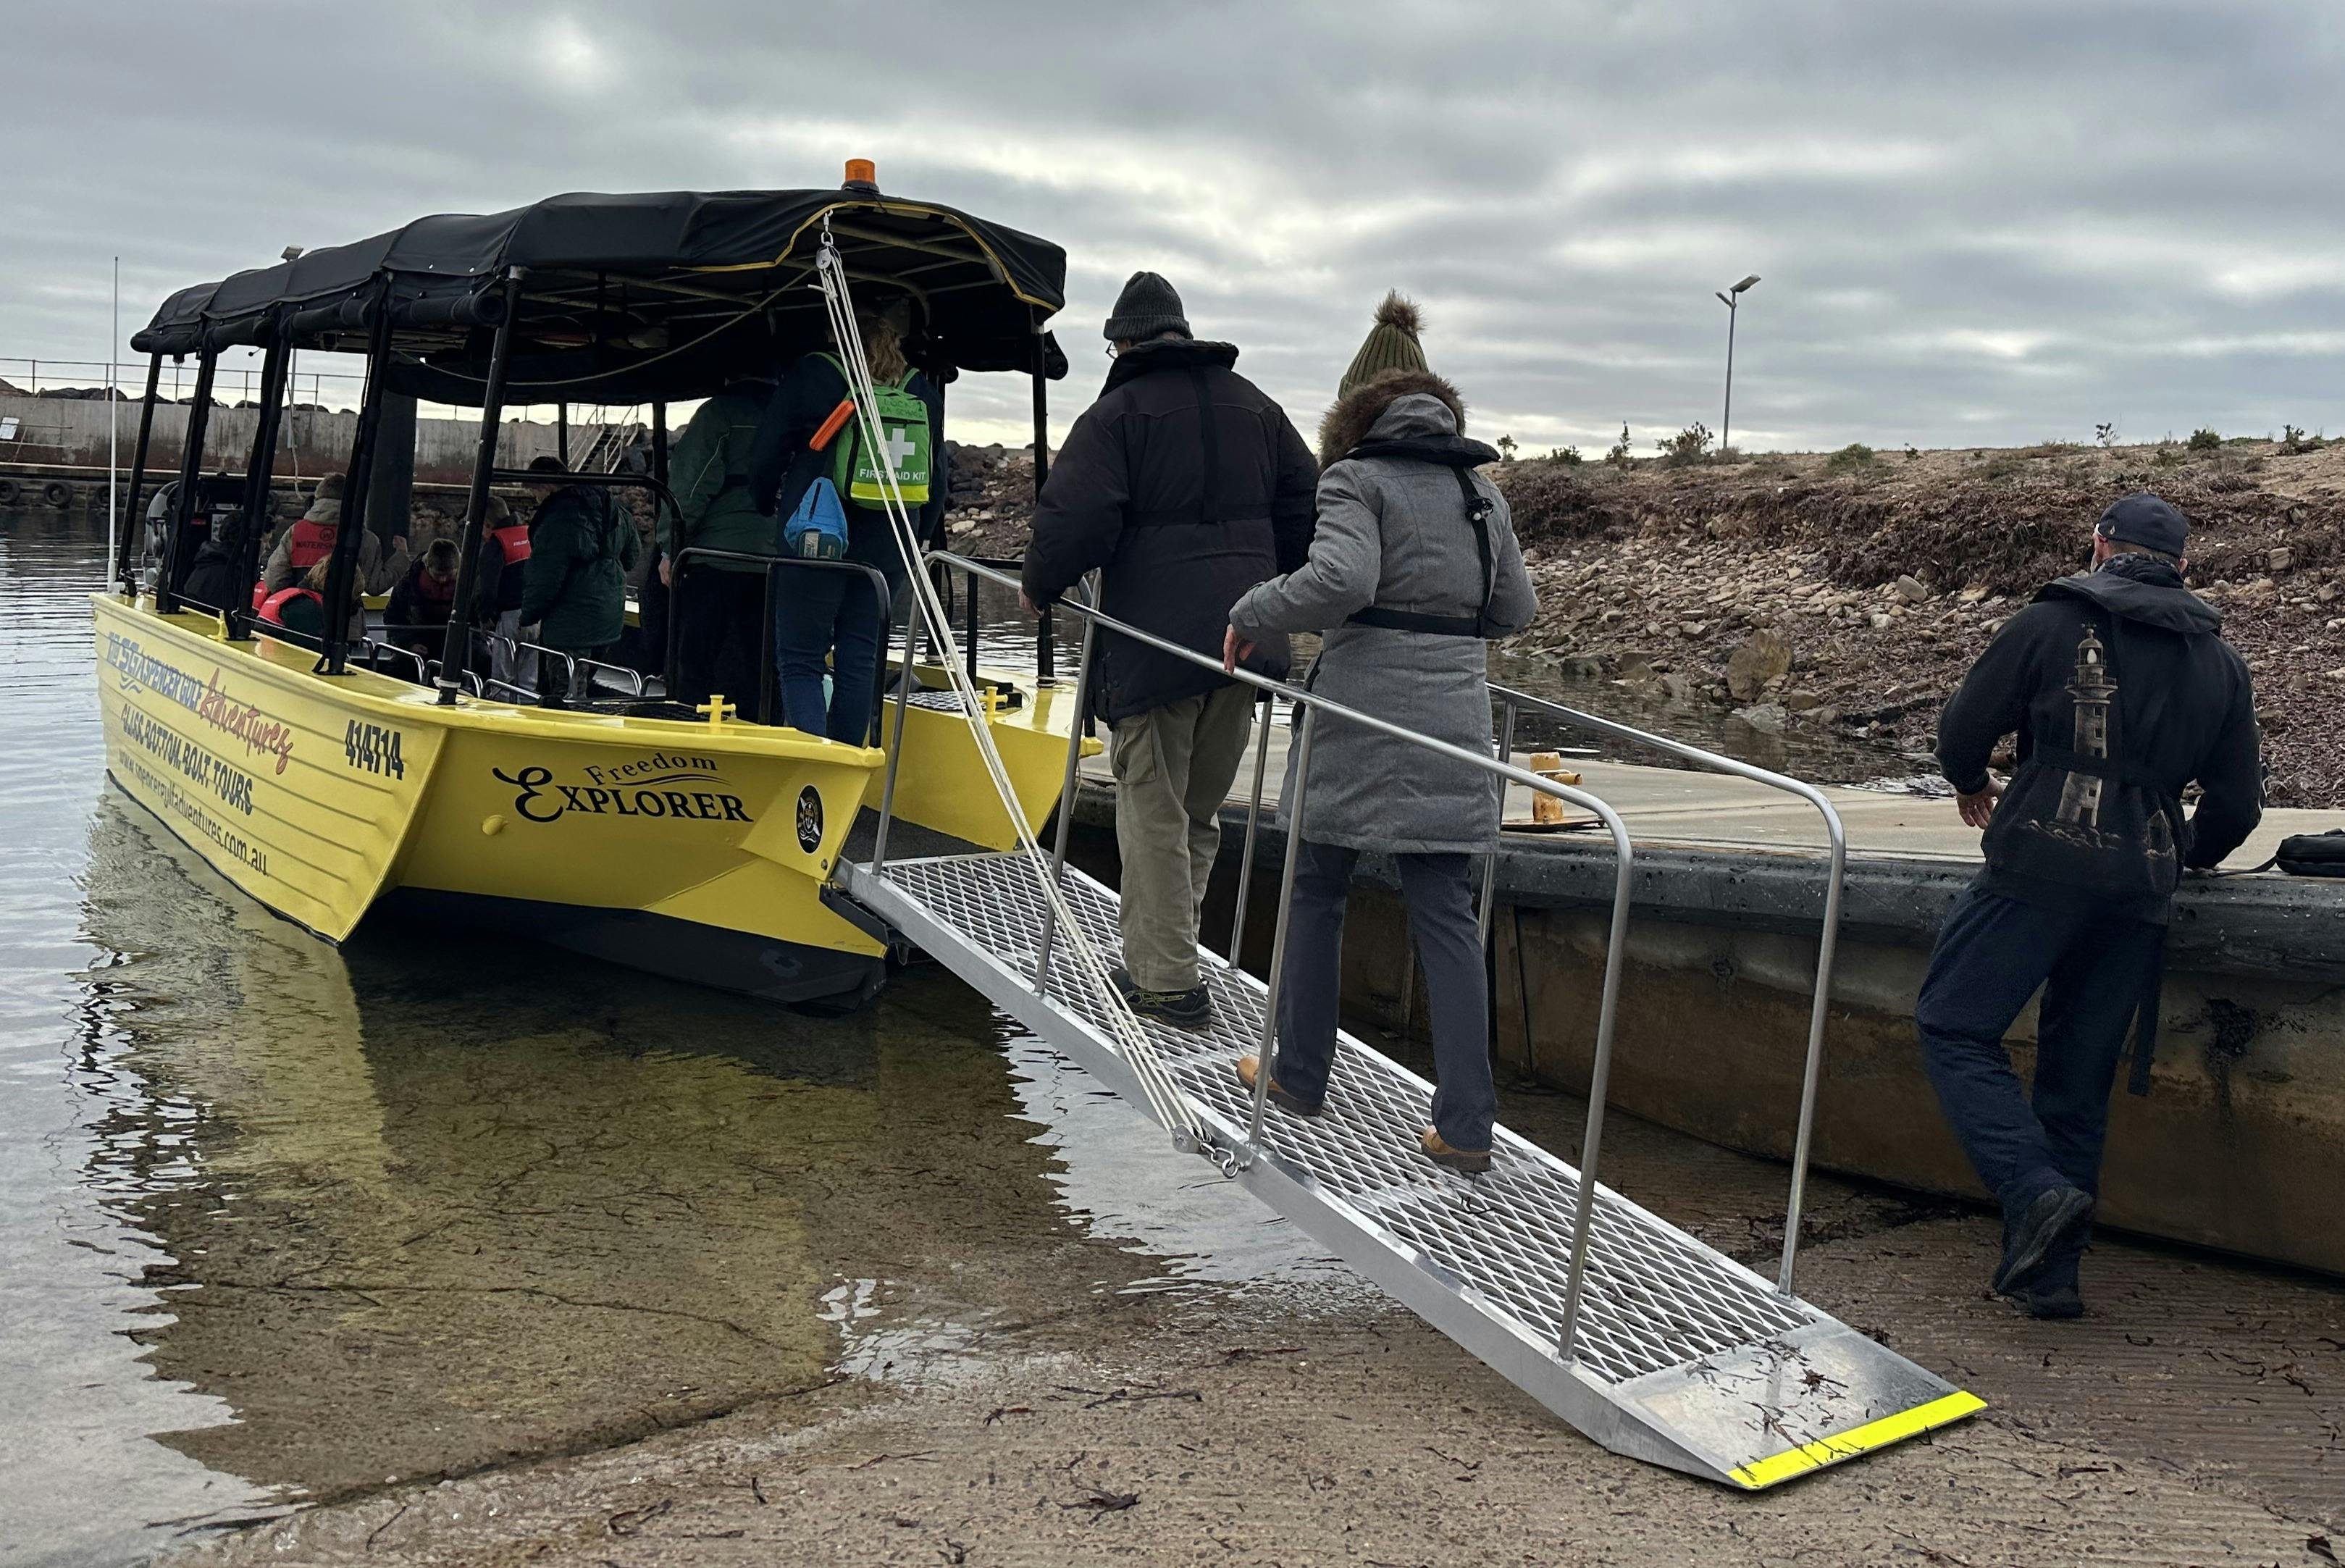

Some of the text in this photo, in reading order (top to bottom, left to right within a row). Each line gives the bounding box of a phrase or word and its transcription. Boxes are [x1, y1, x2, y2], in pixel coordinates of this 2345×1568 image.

[860, 469, 926, 481] FIRS AID KIT
[295, 540, 335, 550] WATERSN
[142, 655, 181, 701] SPENCER
[178, 672, 203, 712] GULF
[121, 703, 253, 816] GLASS BOTTOM BOAT TOURS
[345, 719, 404, 781] 414714
[583, 752, 718, 786] Freedom
[492, 766, 754, 823] EXPLORER
